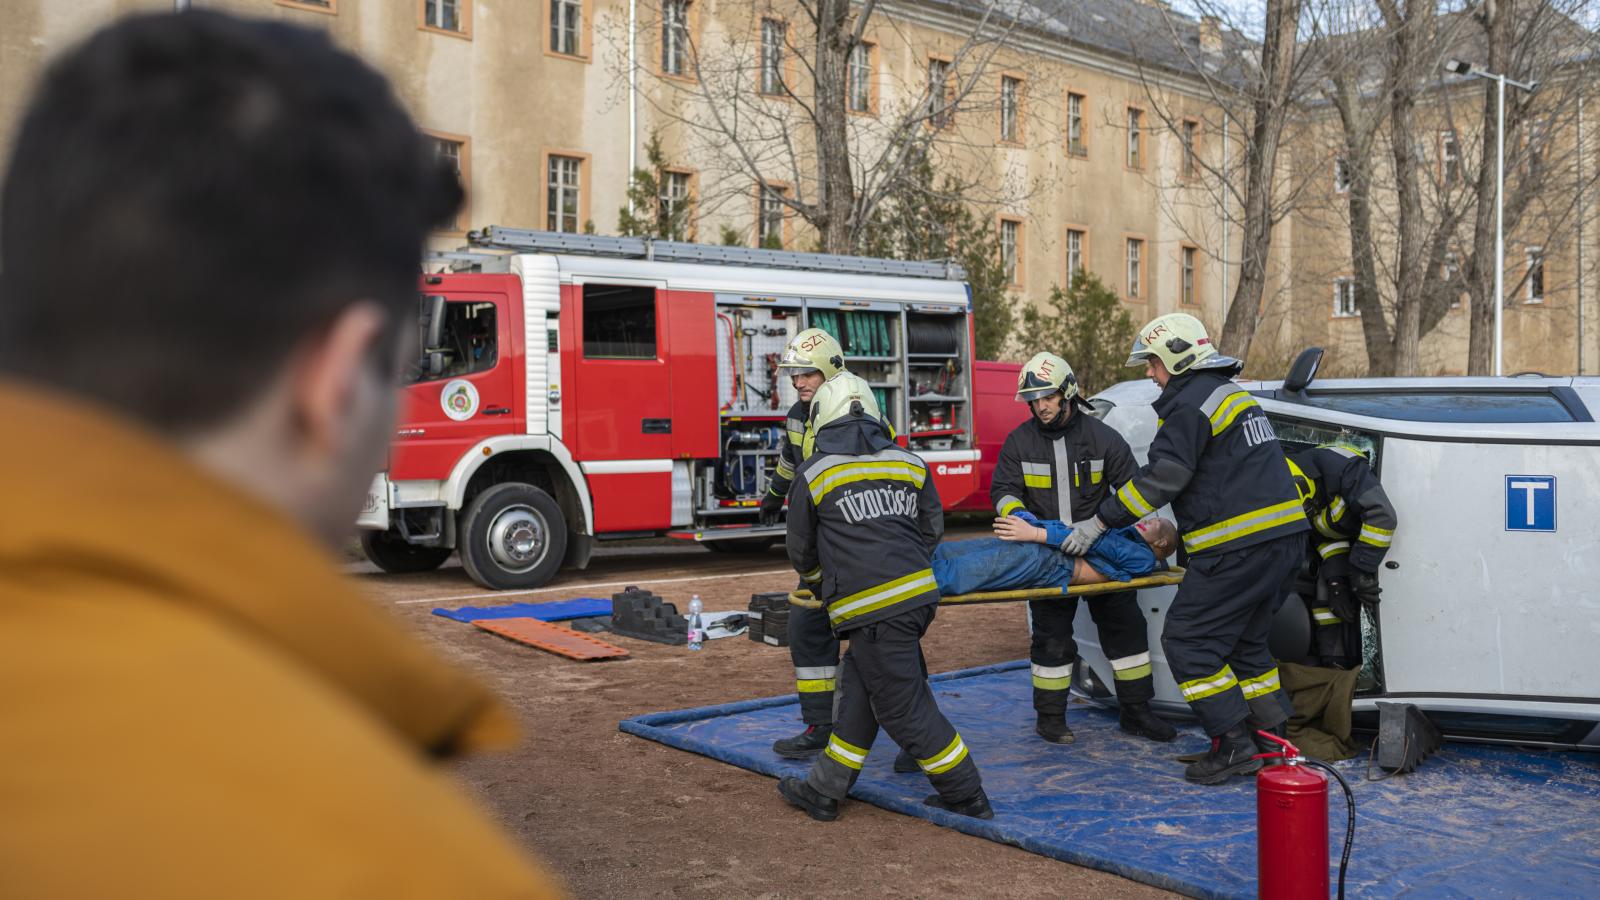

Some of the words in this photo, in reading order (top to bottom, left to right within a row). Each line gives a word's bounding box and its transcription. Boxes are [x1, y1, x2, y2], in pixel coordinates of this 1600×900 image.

[801, 334, 827, 352] SZT
[1145, 325, 1167, 344] KR
[1037, 360, 1055, 380] MT
[1511, 482, 1549, 525] T
